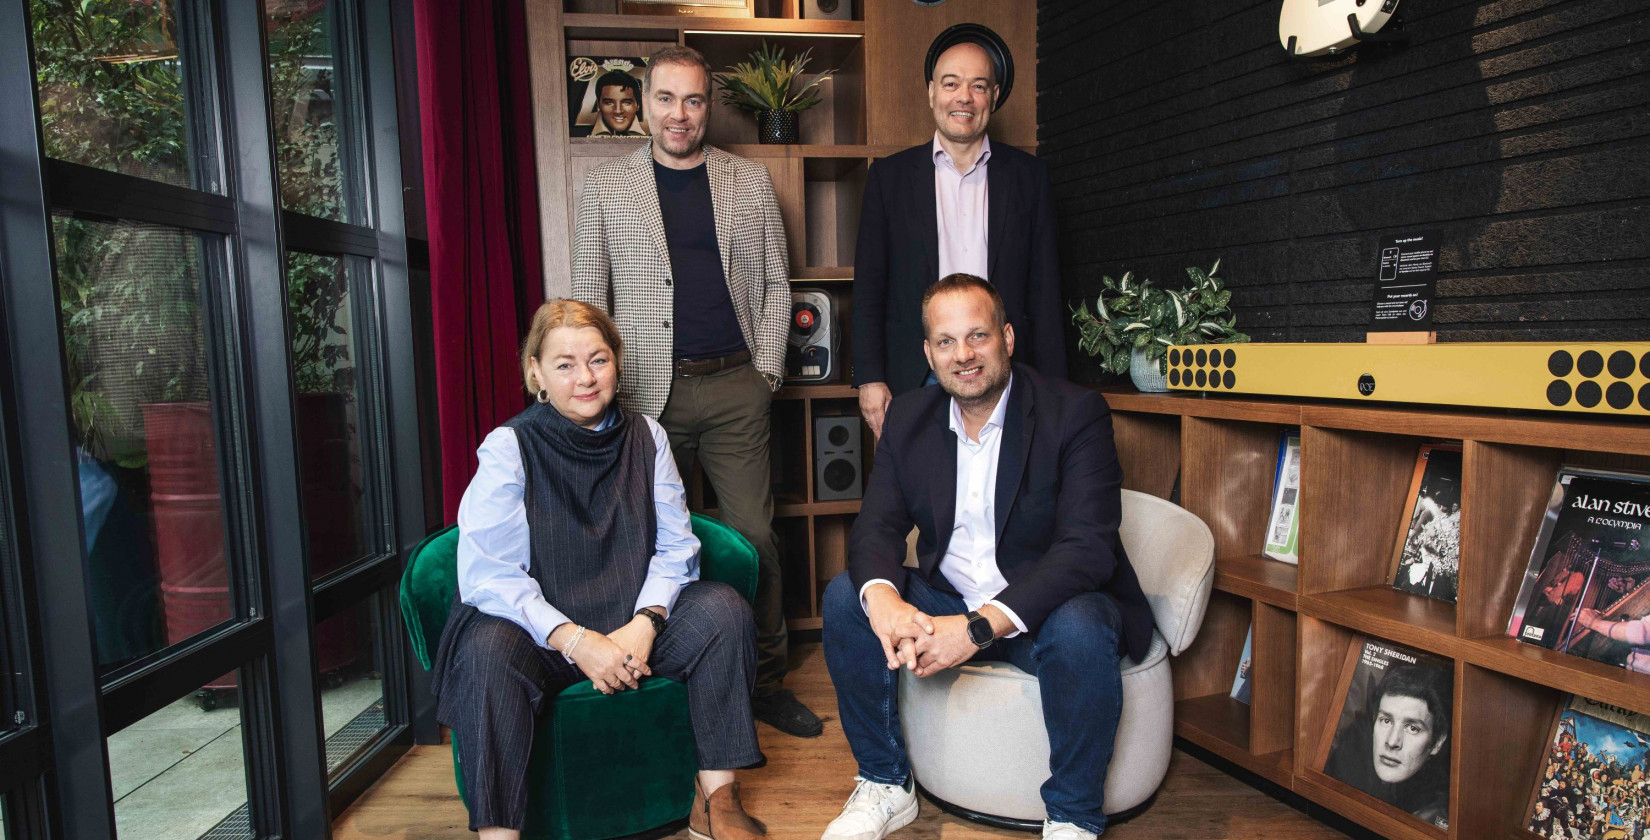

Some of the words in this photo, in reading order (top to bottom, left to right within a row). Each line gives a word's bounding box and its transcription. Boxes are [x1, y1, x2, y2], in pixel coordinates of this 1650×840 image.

[1572, 495, 1611, 513] alan
[1366, 643, 1384, 654] TONY
[1384, 649, 1417, 664] SHERIDAN
[1372, 656, 1390, 666] SINGLES
